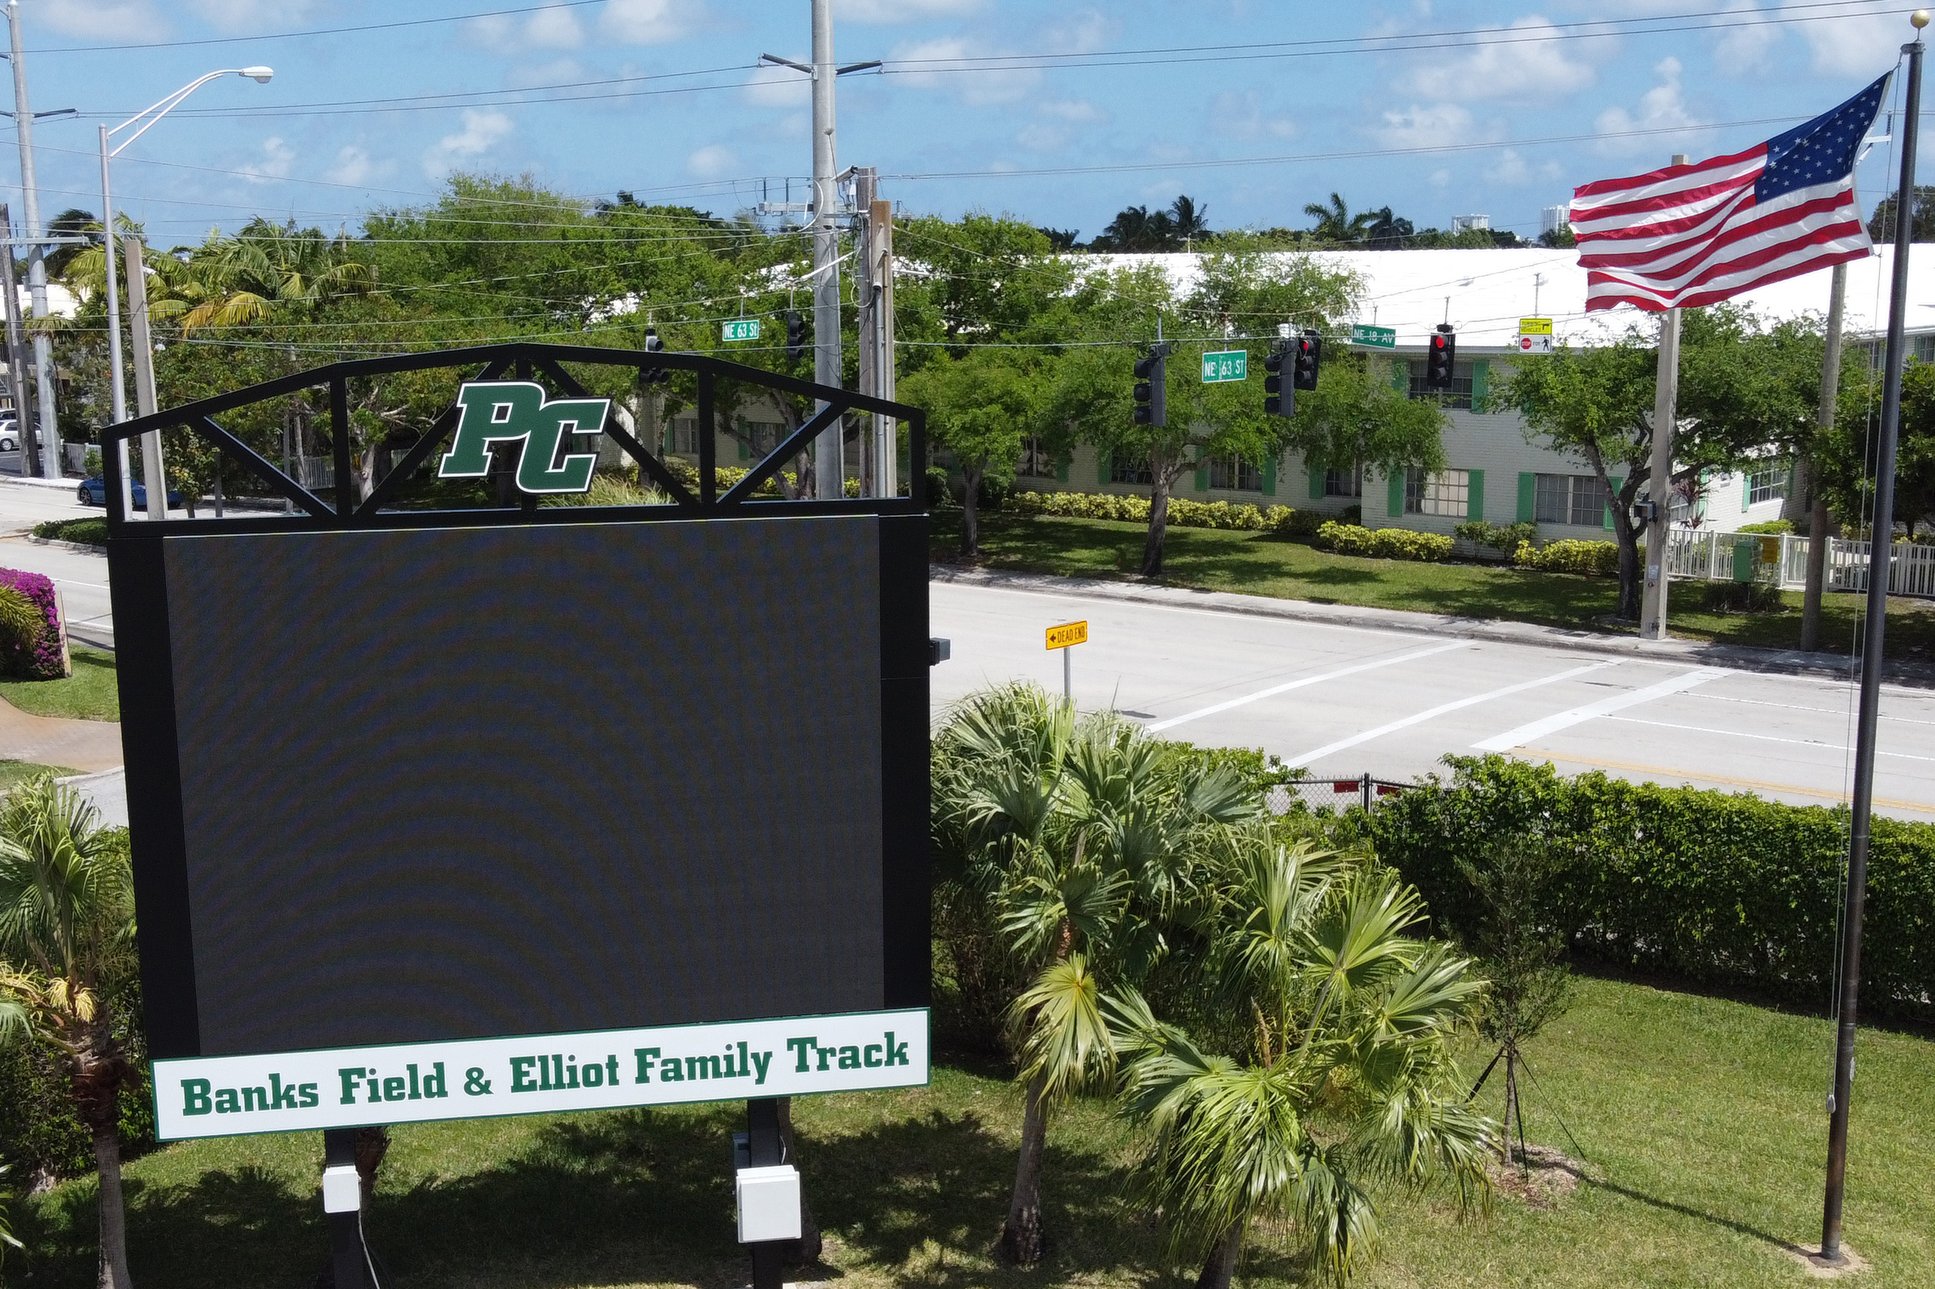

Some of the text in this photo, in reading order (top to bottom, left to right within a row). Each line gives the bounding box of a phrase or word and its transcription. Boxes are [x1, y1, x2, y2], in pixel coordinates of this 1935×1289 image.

[724, 322, 757, 339] NE 63 St
[1353, 328, 1365, 341] NE
[1381, 332, 1394, 344] AV
[1204, 359, 1244, 377] NE 63 ST
[438, 381, 611, 494] PC
[1057, 625, 1085, 644] DEAD END
[181, 1032, 909, 1116] Banks Field & Elliot Family Track
